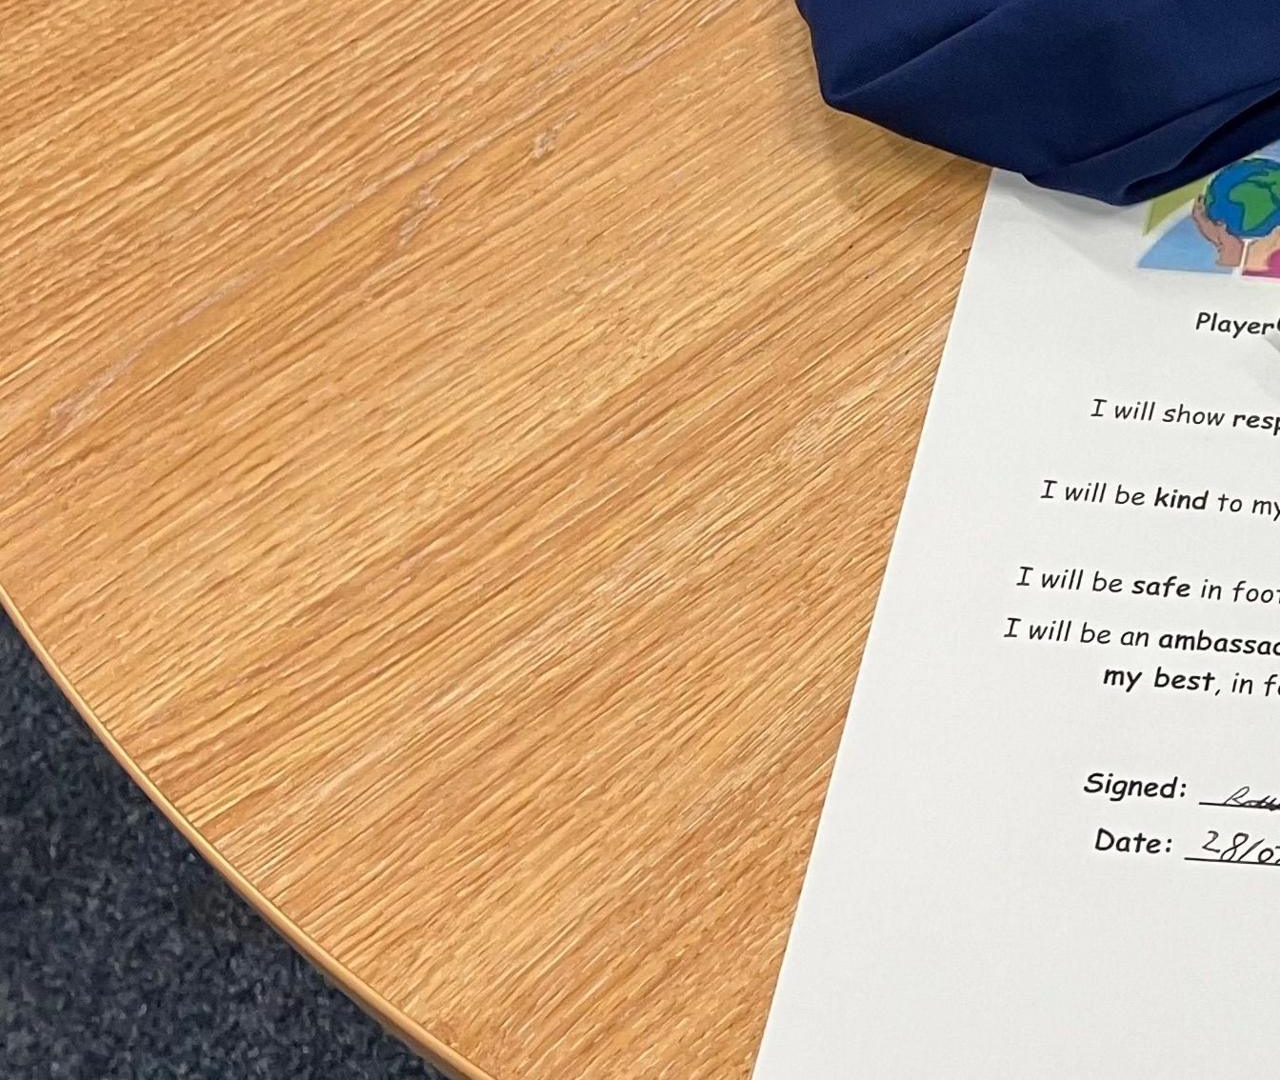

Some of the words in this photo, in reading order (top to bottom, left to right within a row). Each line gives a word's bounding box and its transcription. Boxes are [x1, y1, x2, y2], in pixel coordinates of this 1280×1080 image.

[1195, 312, 1275, 339] Player
[1090, 398, 1108, 417] I
[1115, 401, 1156, 421] will
[1162, 403, 1226, 426] show
[1040, 479, 1058, 499] I
[1065, 482, 1107, 503] will
[1114, 484, 1145, 506] be
[1154, 486, 1209, 510] kind
[1217, 493, 1243, 513] to
[1016, 566, 1034, 586] I
[1041, 568, 1084, 590] will
[1092, 570, 1123, 593] be
[1131, 575, 1191, 598] safe
[1200, 578, 1222, 601] in
[1003, 617, 1022, 638] I
[1029, 619, 1072, 642] will
[1080, 621, 1111, 645] be
[1120, 631, 1149, 648] an
[1103, 669, 1143, 693] my
[1154, 666, 1221, 696] best,
[1231, 672, 1253, 695] in
[1083, 772, 1187, 802] Signed:
[1094, 827, 1172, 854] Date:
